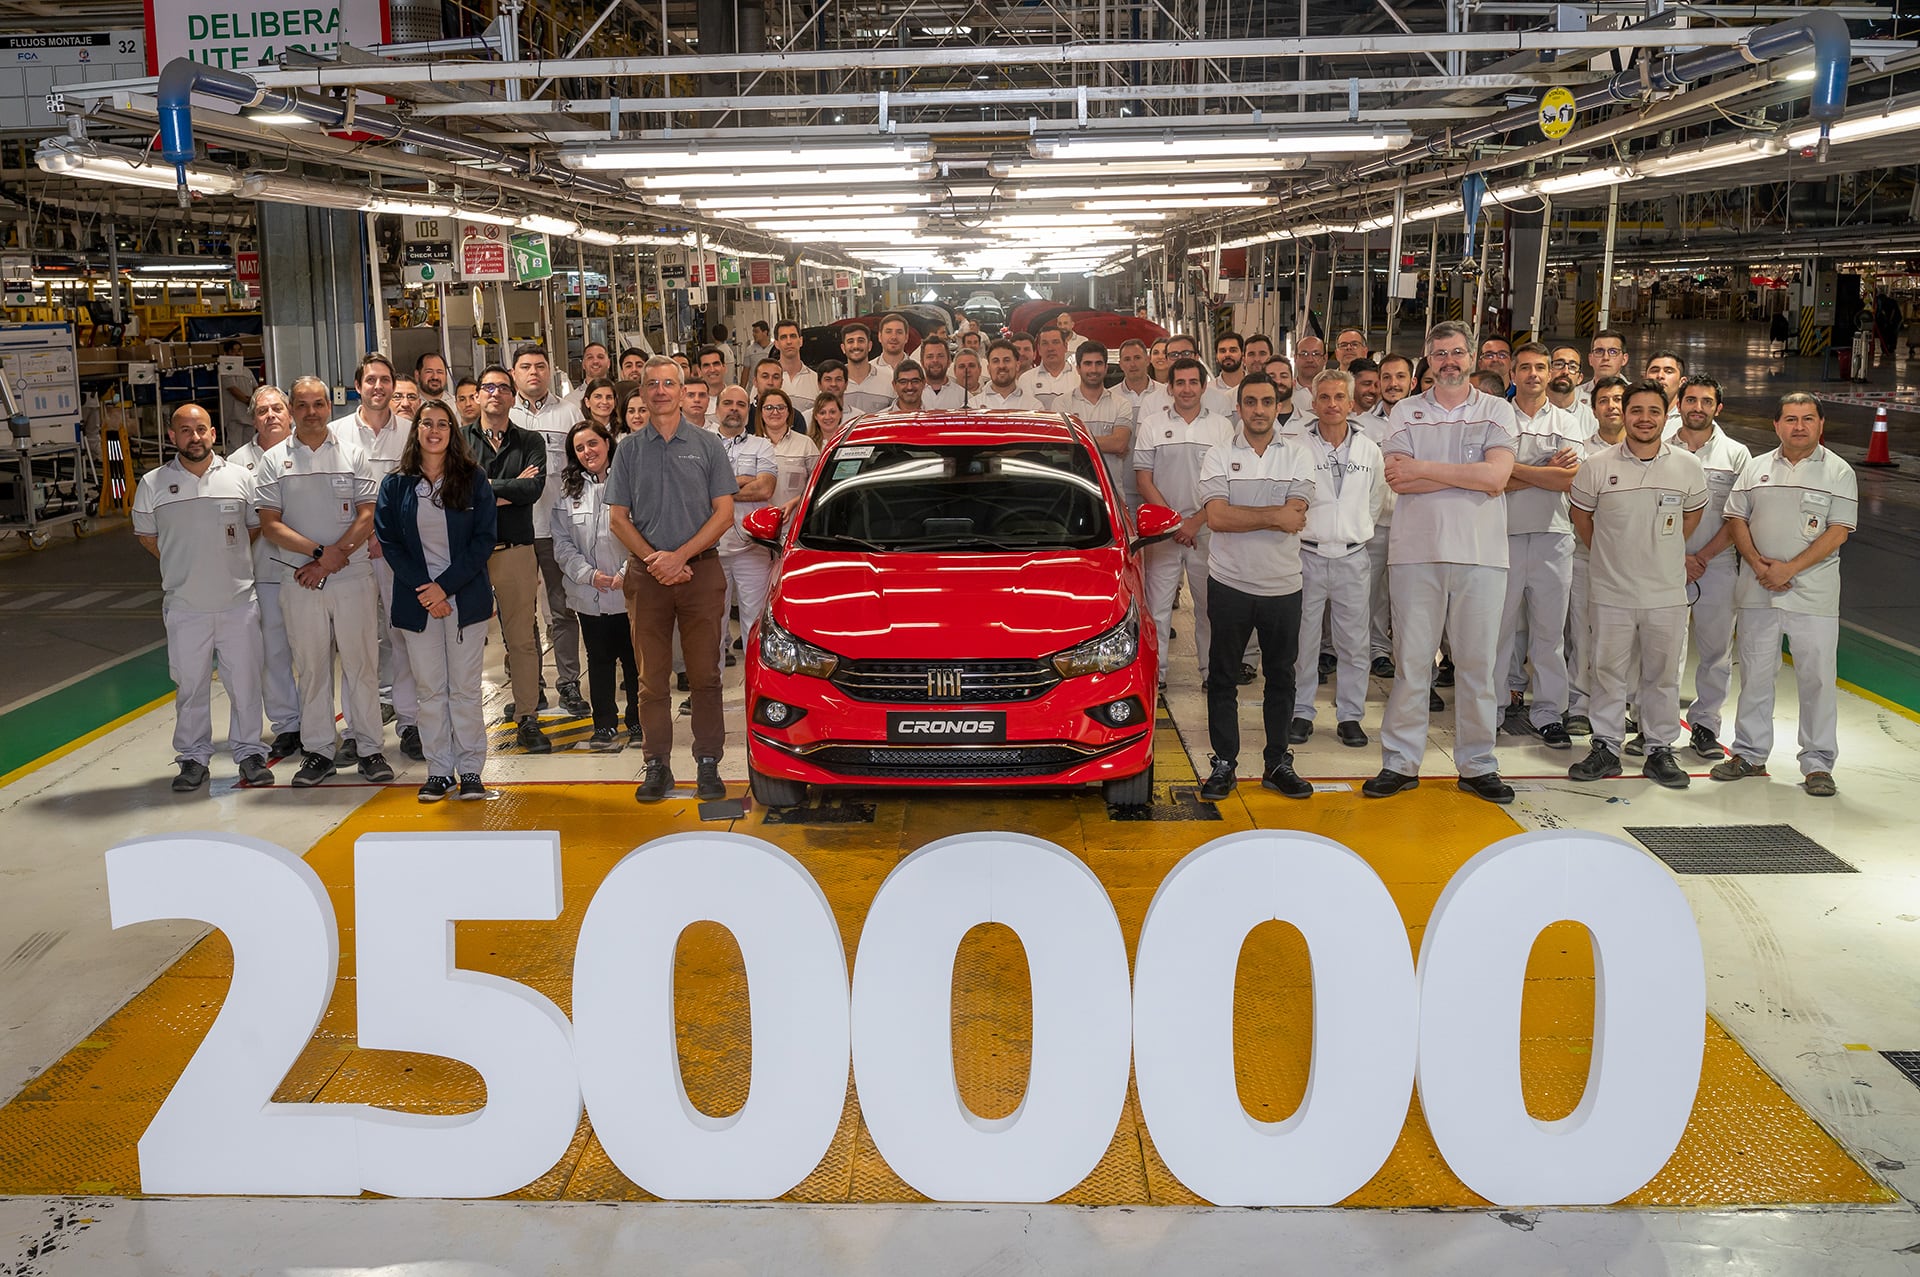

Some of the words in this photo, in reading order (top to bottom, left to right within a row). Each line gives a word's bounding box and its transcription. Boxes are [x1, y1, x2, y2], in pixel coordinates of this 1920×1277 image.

[188, 8, 348, 41] DELIBERA
[10, 38, 47, 48] FLUJOS
[48, 36, 93, 46] MONTAJE
[118, 40, 136, 54] 32
[17, 52, 39, 61] FCA
[416, 221, 438, 238] 108
[927, 668, 964, 697] FIAT
[898, 720, 995, 734] CRONOS
[106, 830, 1707, 1207] 250000
